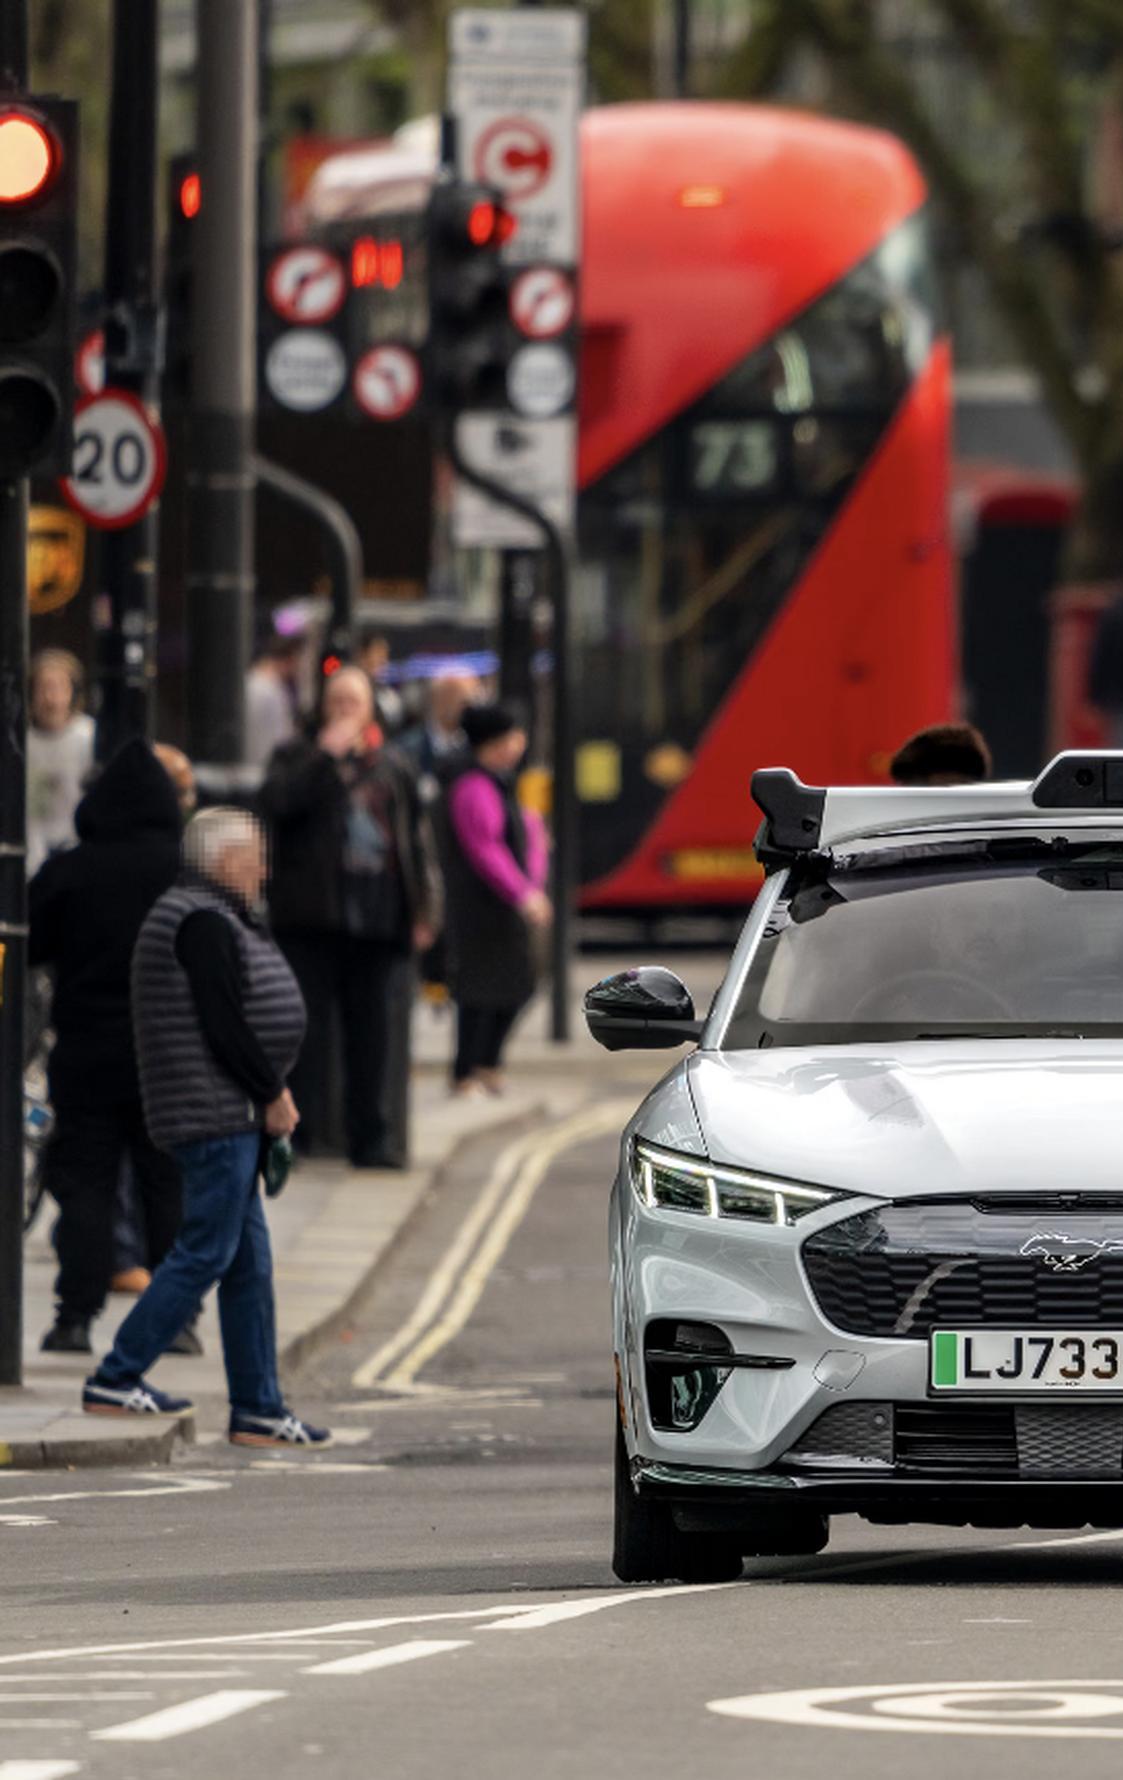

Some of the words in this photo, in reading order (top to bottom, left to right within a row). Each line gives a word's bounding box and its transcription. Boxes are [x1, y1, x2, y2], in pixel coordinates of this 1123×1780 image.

[76, 430, 146, 487] 20
[693, 422, 775, 489] 73
[964, 1337, 1119, 1379] LJ733
